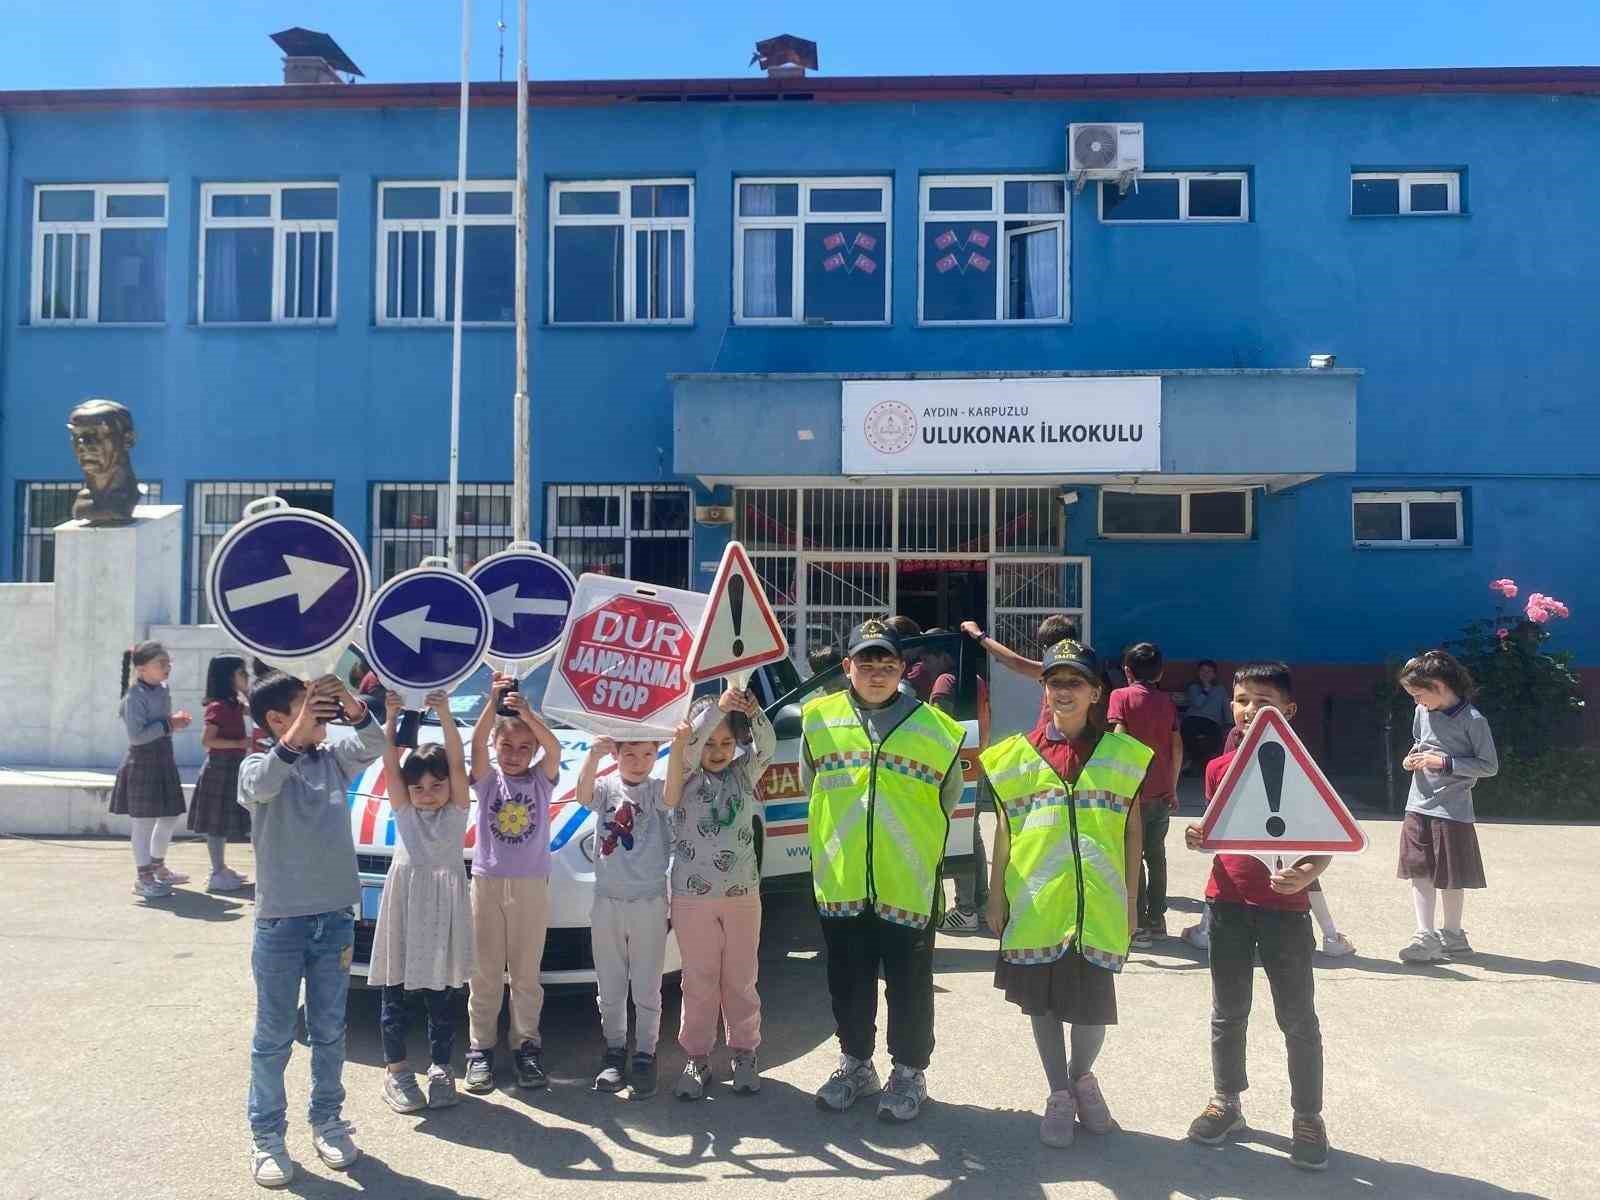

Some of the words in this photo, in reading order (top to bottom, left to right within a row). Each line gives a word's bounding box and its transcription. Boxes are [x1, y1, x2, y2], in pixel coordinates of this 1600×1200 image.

[923, 407, 959, 417] AYDIN
[968, 406, 1029, 417] KARPUZLU
[922, 425, 1035, 444] ULUKONAK
[1041, 421, 1143, 443] İLKOKULU
[592, 610, 684, 656] DUR
[569, 646, 681, 690] JANDARMA
[592, 680, 650, 712] STOP
